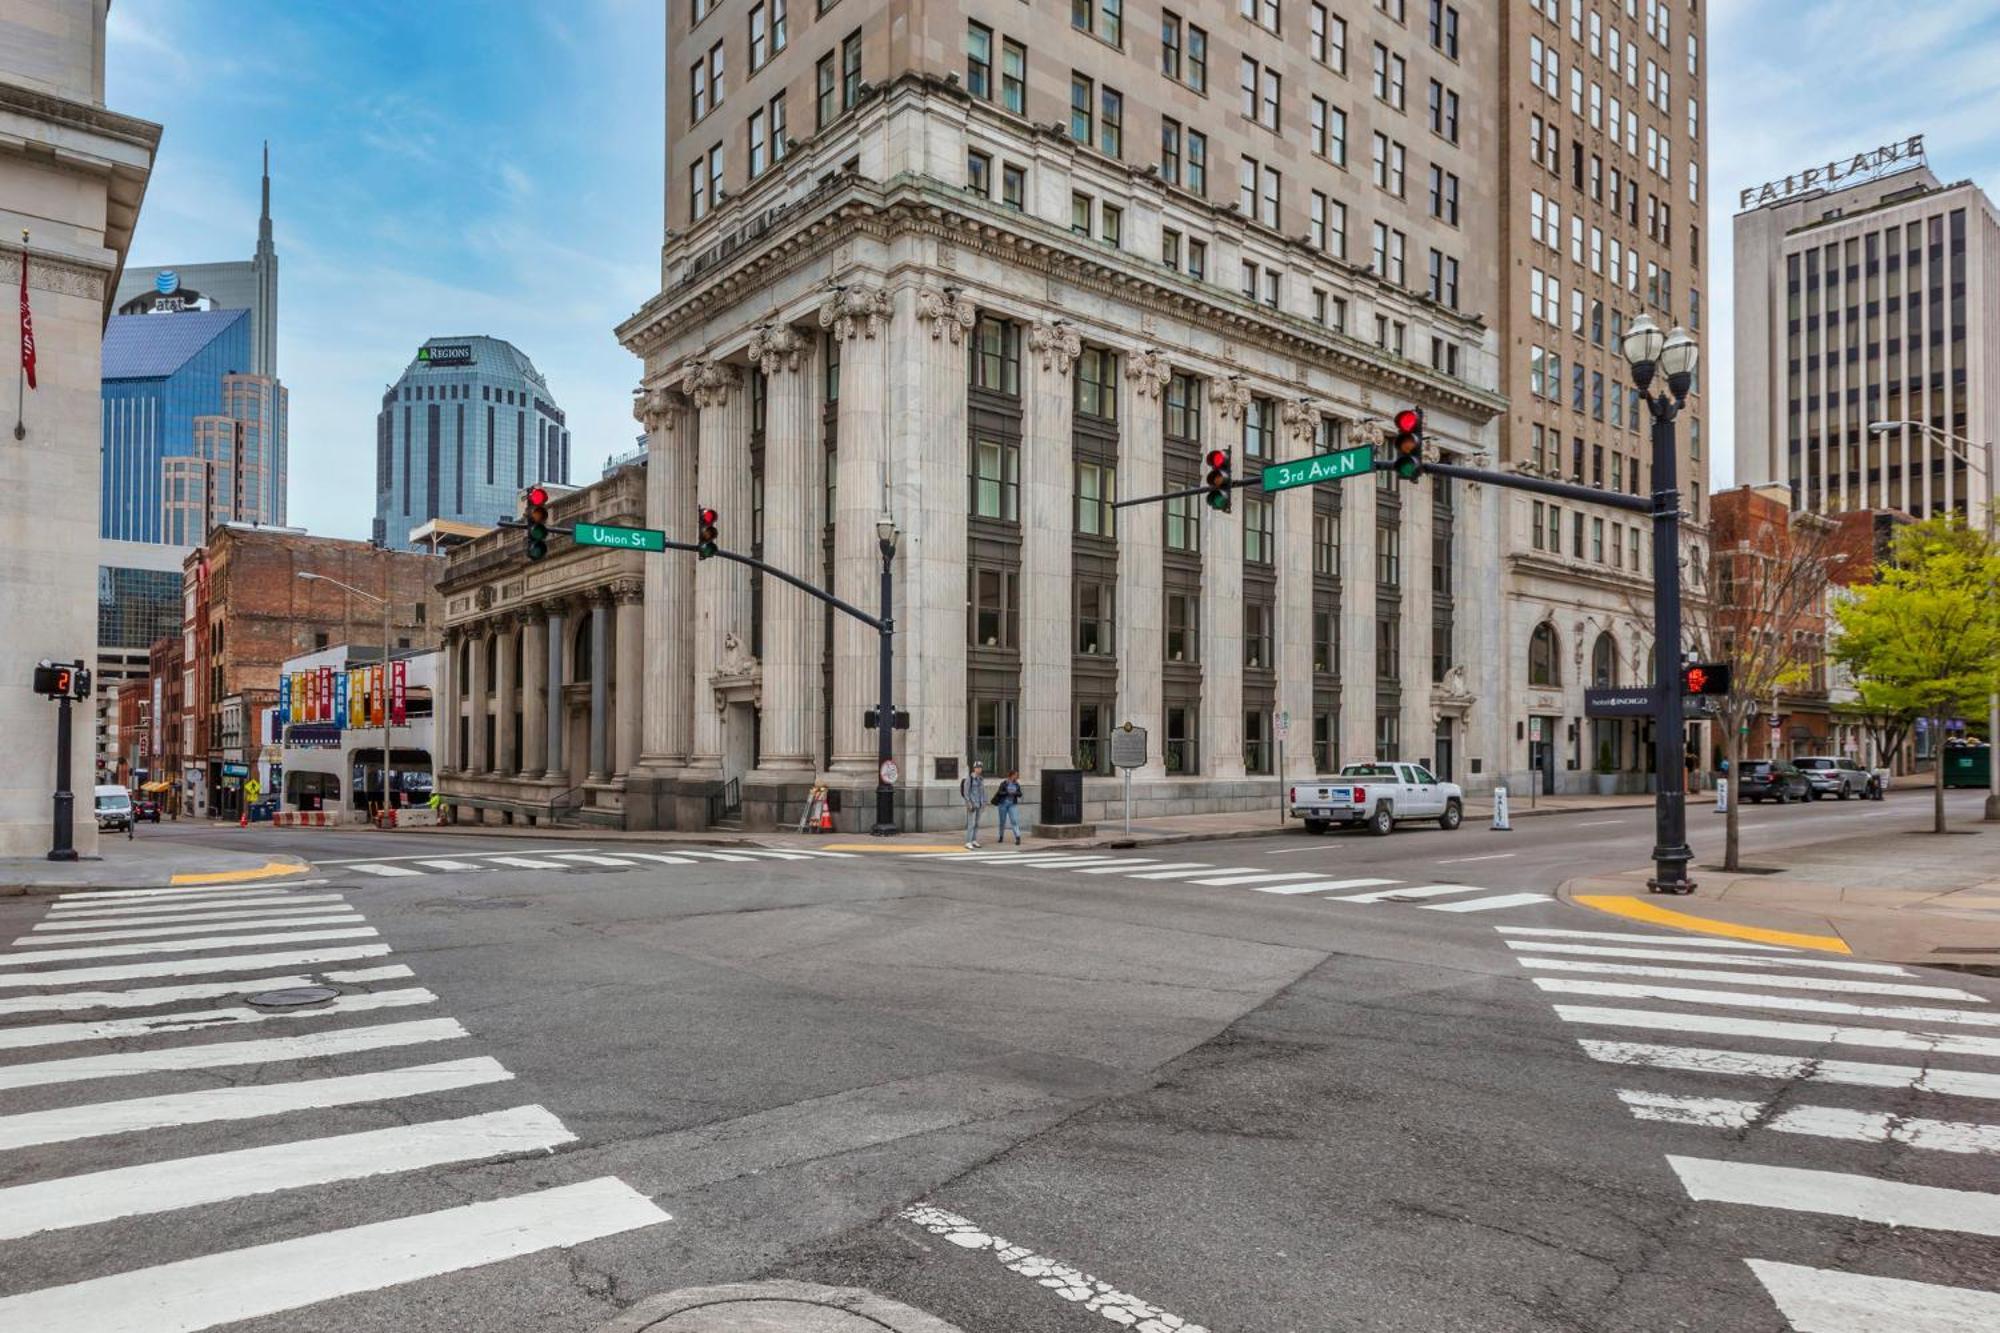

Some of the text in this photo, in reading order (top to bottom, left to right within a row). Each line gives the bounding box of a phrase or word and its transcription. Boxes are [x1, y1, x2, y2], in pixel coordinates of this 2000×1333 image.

[430, 347, 470, 359] REGIONS
[1278, 453, 1355, 484] 3rd Ave N
[592, 527, 646, 547] Union St
[59, 672, 68, 690] 2
[337, 675, 345, 713] PARK
[373, 668, 381, 710] PARK
[395, 664, 403, 708] PARK
